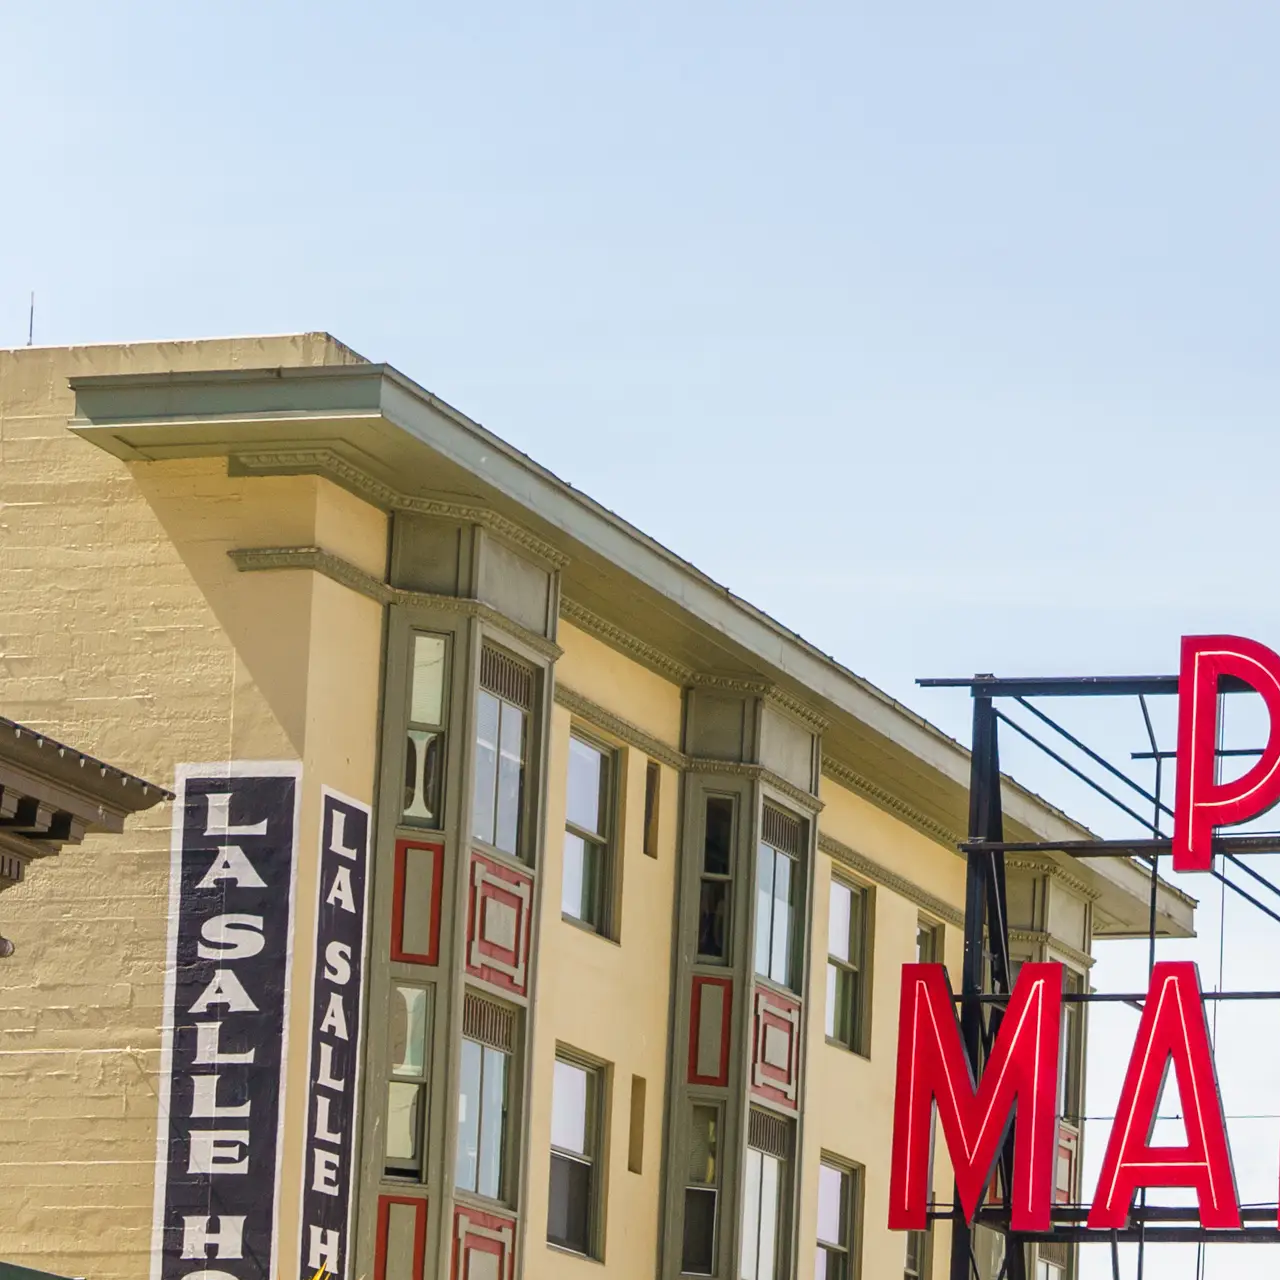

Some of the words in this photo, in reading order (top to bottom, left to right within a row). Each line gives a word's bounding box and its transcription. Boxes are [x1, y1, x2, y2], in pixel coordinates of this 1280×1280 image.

[194, 793, 269, 888] LA
[326, 809, 357, 914] LA
[186, 913, 266, 1176] SALLE
[313, 941, 352, 1197] SALLE
